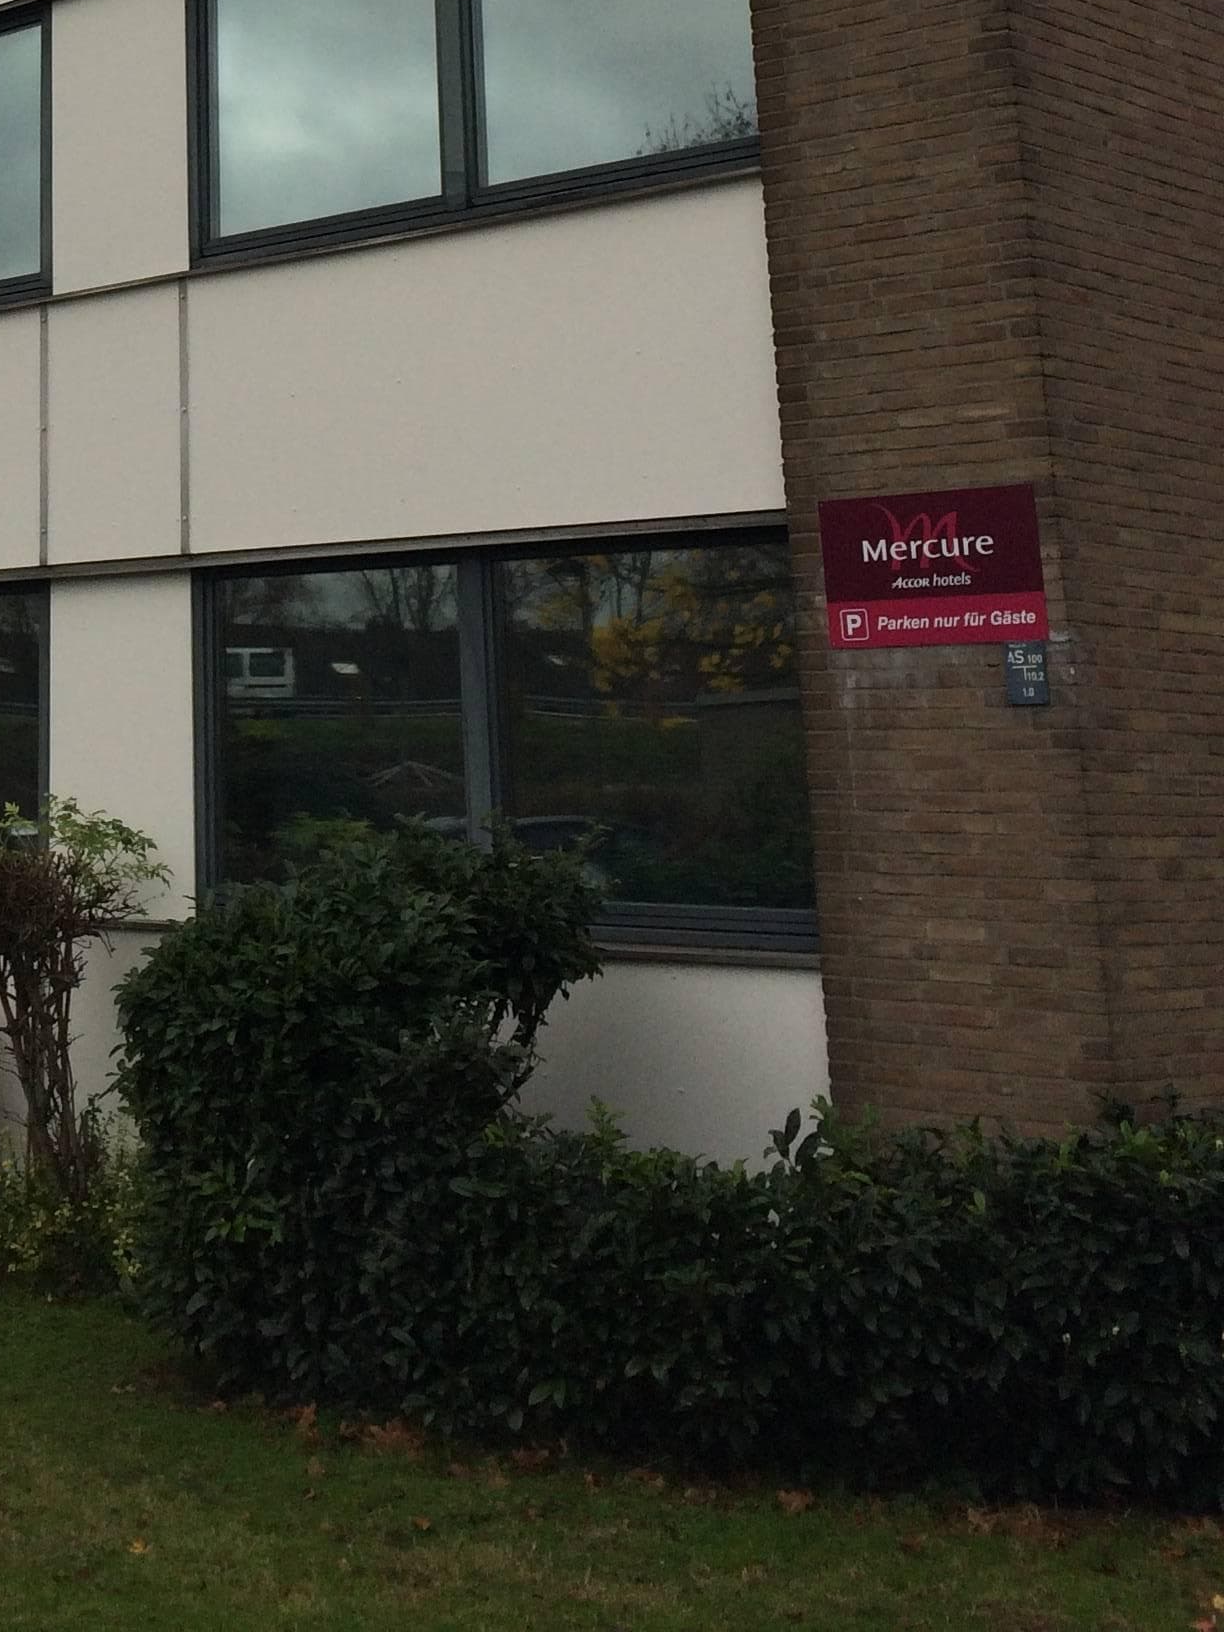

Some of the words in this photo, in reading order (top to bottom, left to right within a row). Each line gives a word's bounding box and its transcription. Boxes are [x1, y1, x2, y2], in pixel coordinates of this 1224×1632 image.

[861, 535, 994, 562] Mercure
[932, 572, 972, 587] hotels
[846, 614, 862, 636] P
[877, 615, 929, 631] Parken
[934, 615, 960, 628] nur
[963, 611, 986, 626] für
[990, 609, 1037, 626] Gäste
